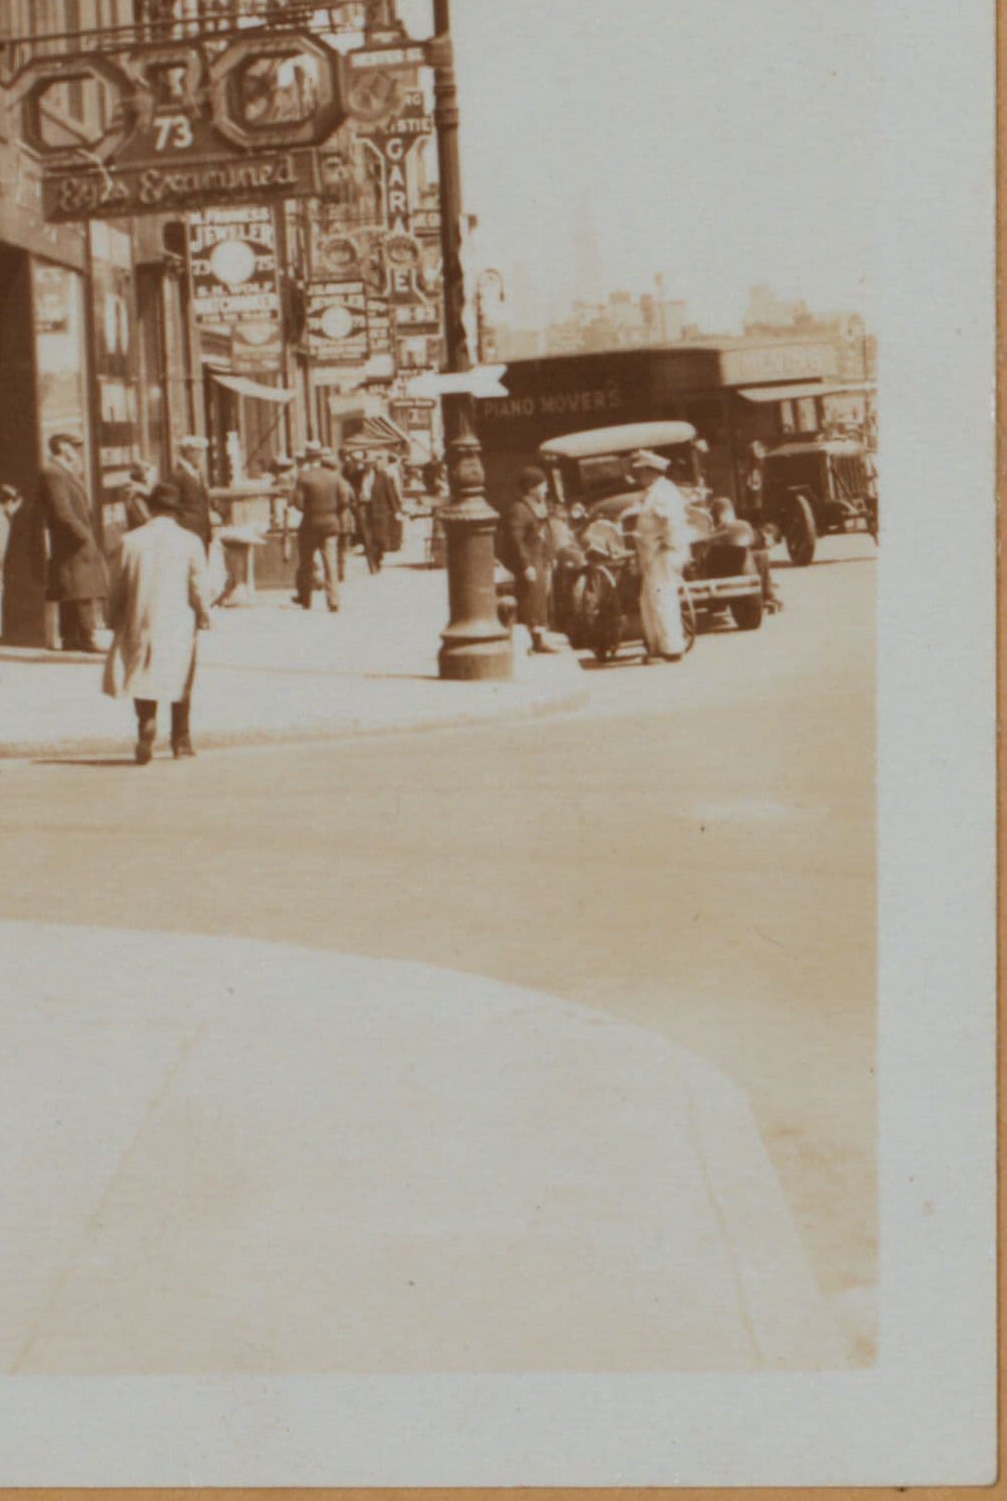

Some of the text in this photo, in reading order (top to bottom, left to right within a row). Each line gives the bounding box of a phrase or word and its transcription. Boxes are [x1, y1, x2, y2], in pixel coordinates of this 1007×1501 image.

[153, 115, 194, 150] 73
[141, 153, 298, 204] Examined
[484, 388, 622, 417] PIANO MOVERS
